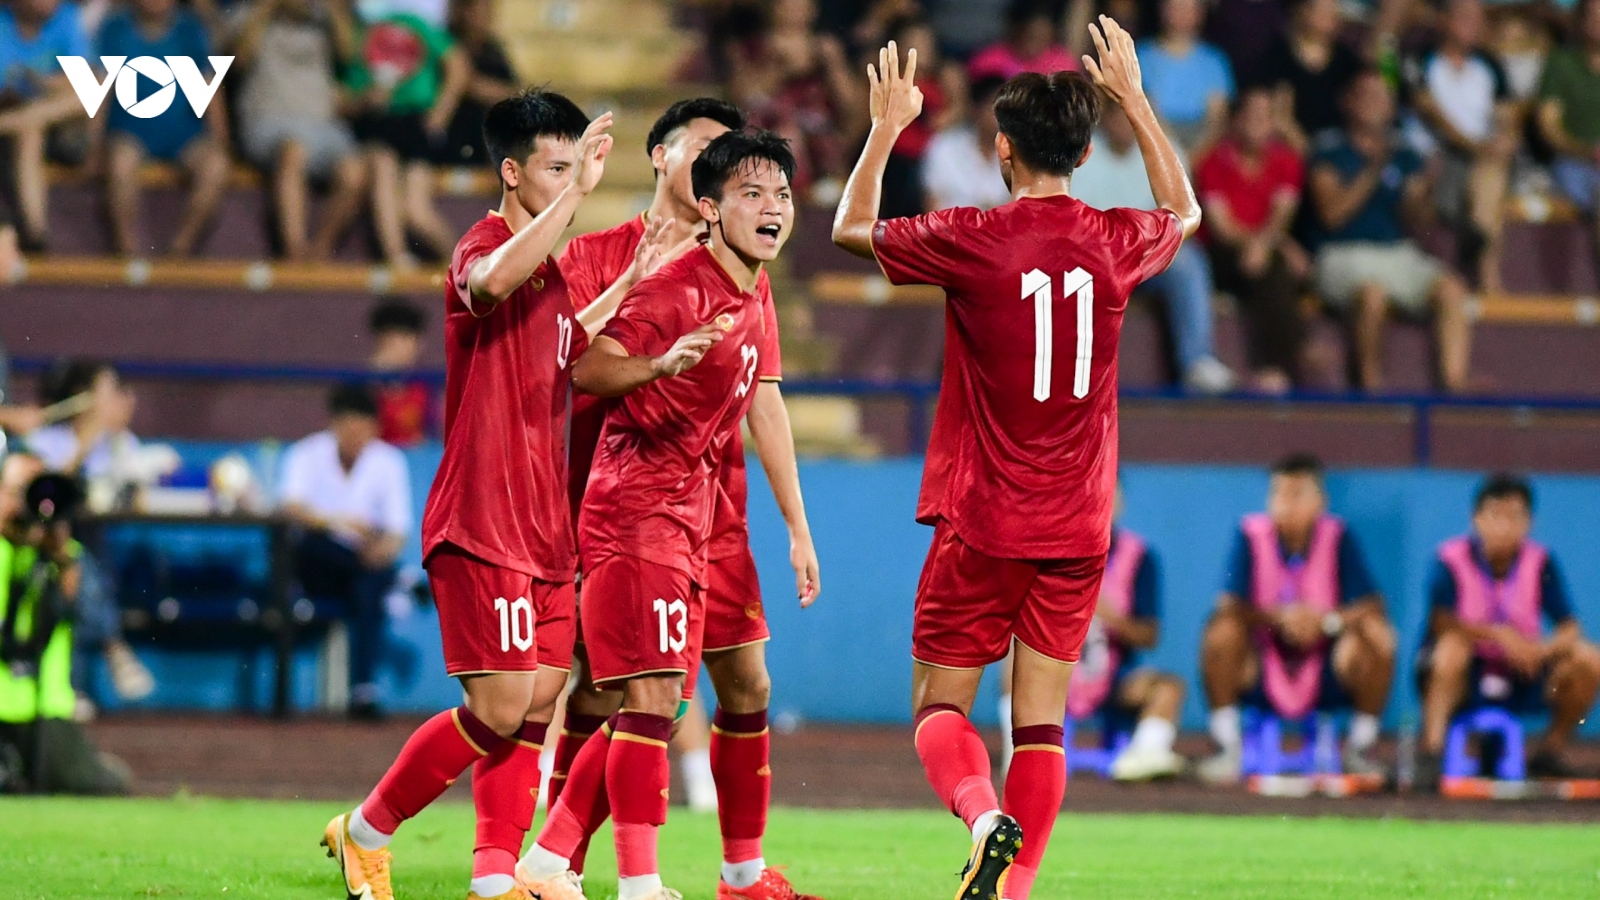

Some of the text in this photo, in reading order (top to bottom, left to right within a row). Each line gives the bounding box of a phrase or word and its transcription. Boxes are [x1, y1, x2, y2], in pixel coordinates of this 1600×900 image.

[557, 313, 572, 370] 10
[1021, 266, 1094, 402] 11
[494, 596, 533, 652] 10
[653, 598, 687, 653] 13
